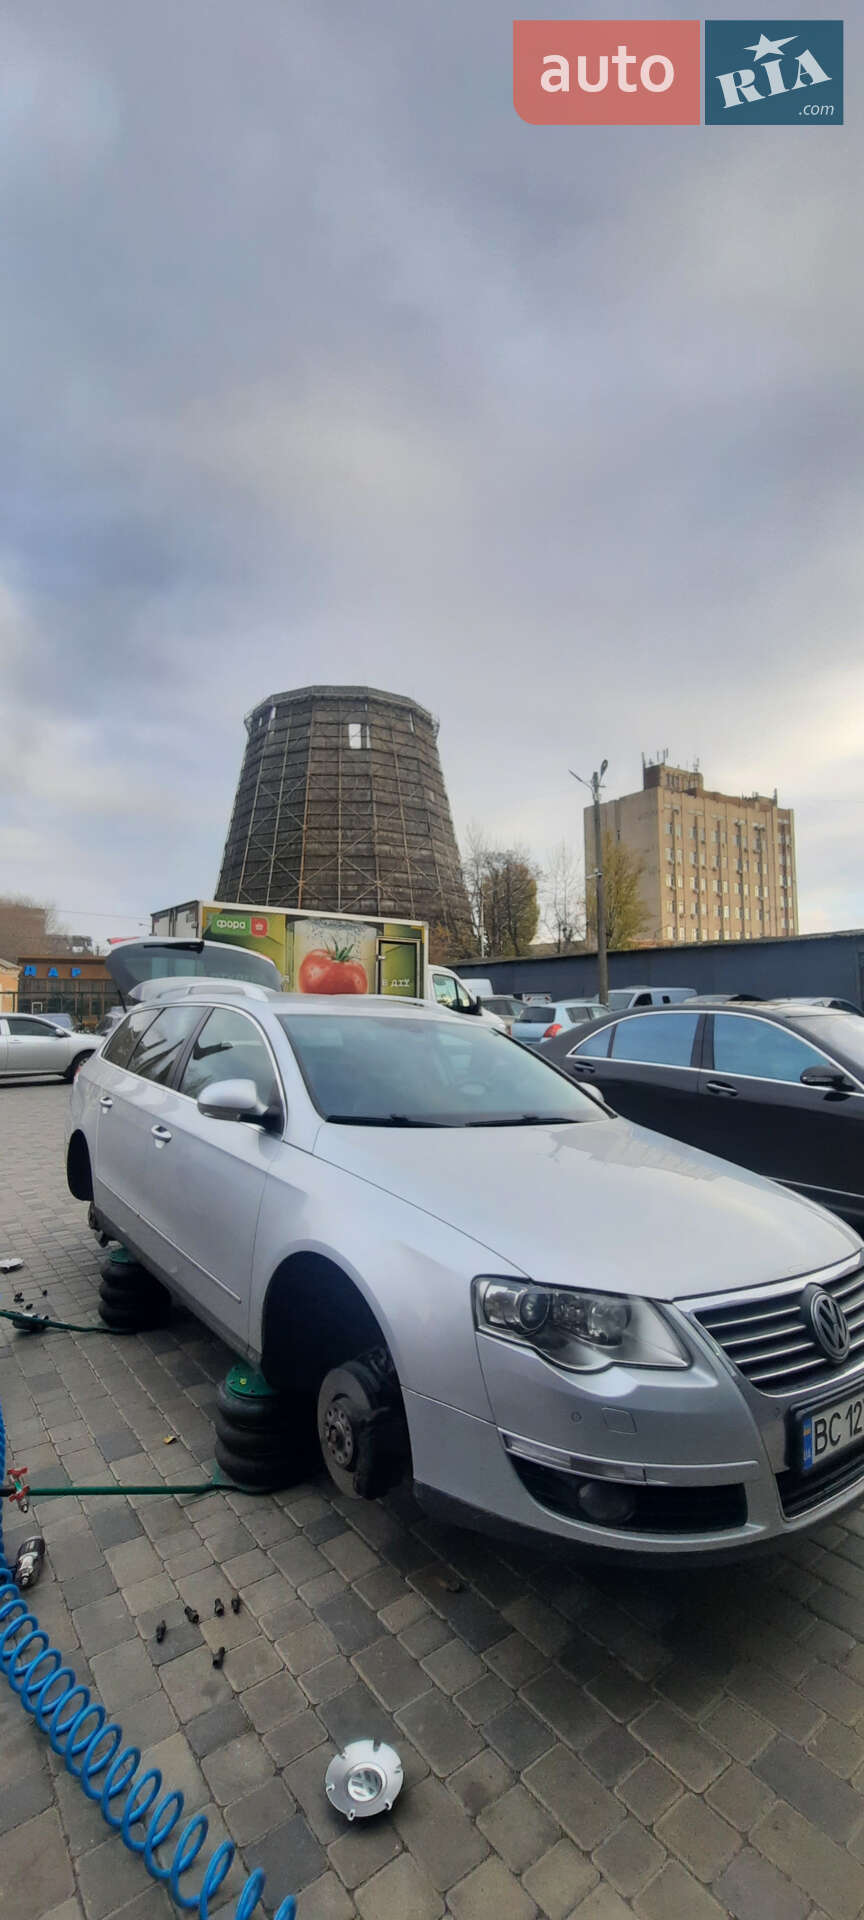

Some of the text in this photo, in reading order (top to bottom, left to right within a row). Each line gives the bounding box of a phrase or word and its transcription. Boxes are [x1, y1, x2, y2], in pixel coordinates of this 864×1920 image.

[216, 919, 246, 930] фора
[814, 1399, 864, 1456] BC 12
